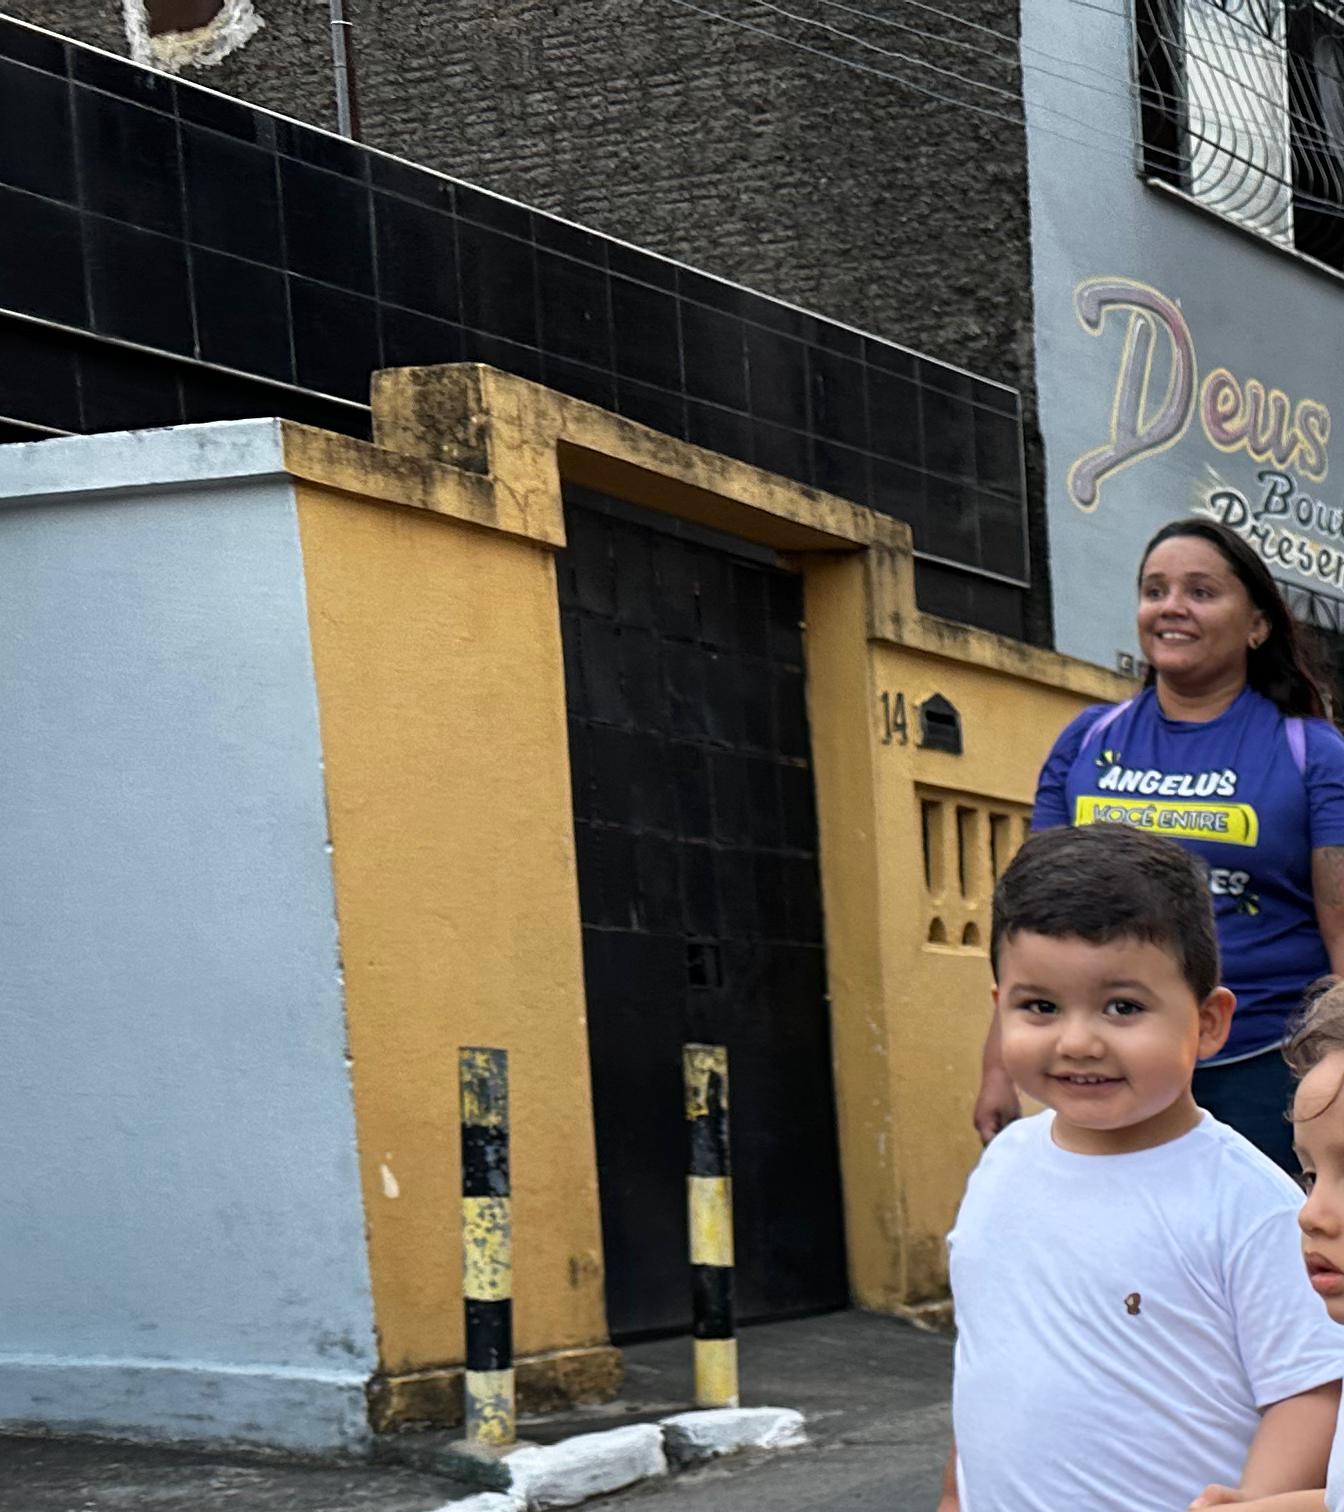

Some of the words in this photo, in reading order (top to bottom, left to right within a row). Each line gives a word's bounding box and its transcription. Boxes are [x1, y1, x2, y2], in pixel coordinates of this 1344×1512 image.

[1066, 276, 1331, 513] Deus
[881, 690, 908, 745] 14
[1098, 765, 1237, 797] ANGELUS
[1094, 804, 1157, 827] VOCÊ
[1158, 809, 1229, 832] ENTRE
